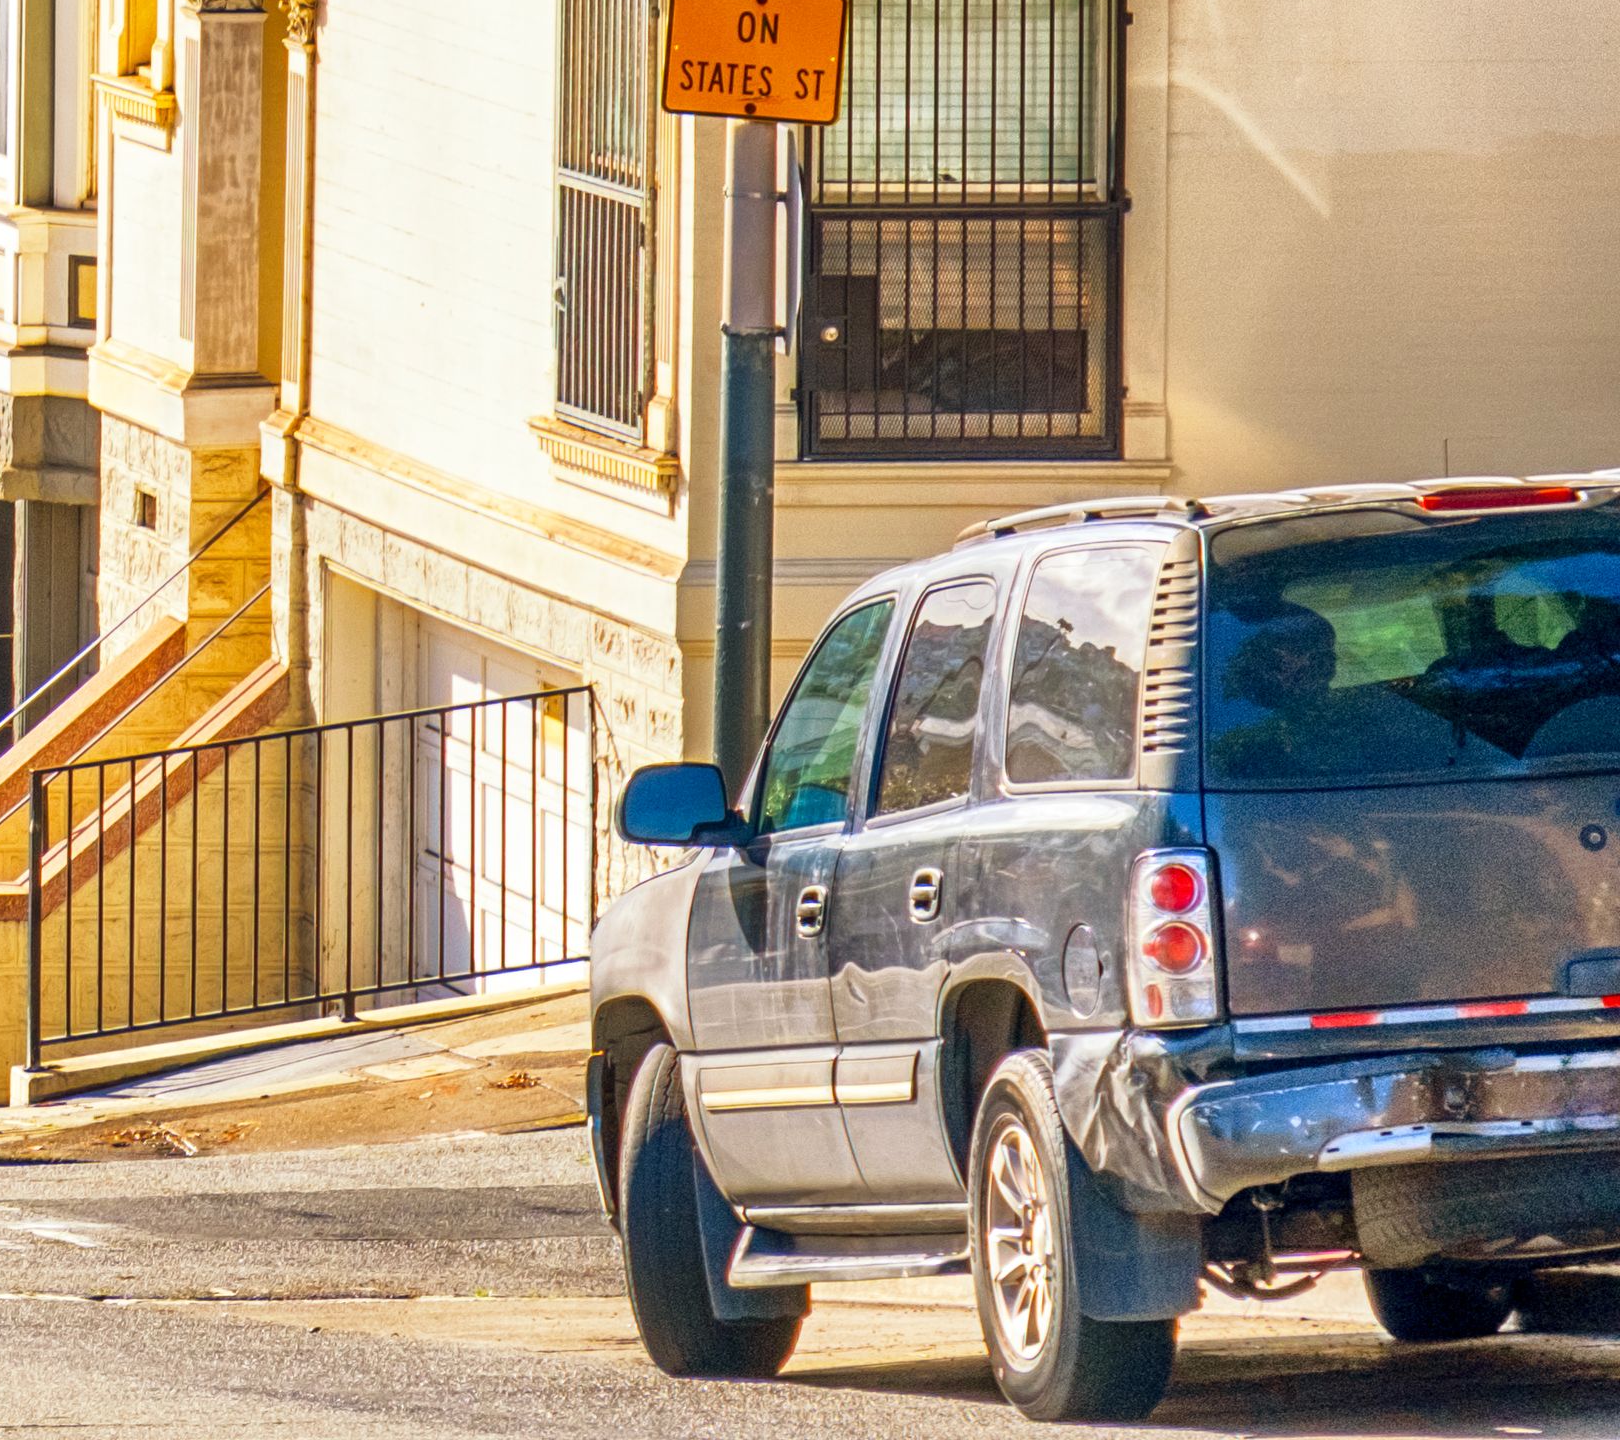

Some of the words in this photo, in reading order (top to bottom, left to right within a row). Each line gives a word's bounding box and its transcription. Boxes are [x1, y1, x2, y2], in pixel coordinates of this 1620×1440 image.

[737, 11, 780, 45] ON
[679, 59, 773, 100] STATES
[794, 69, 828, 103] ST
